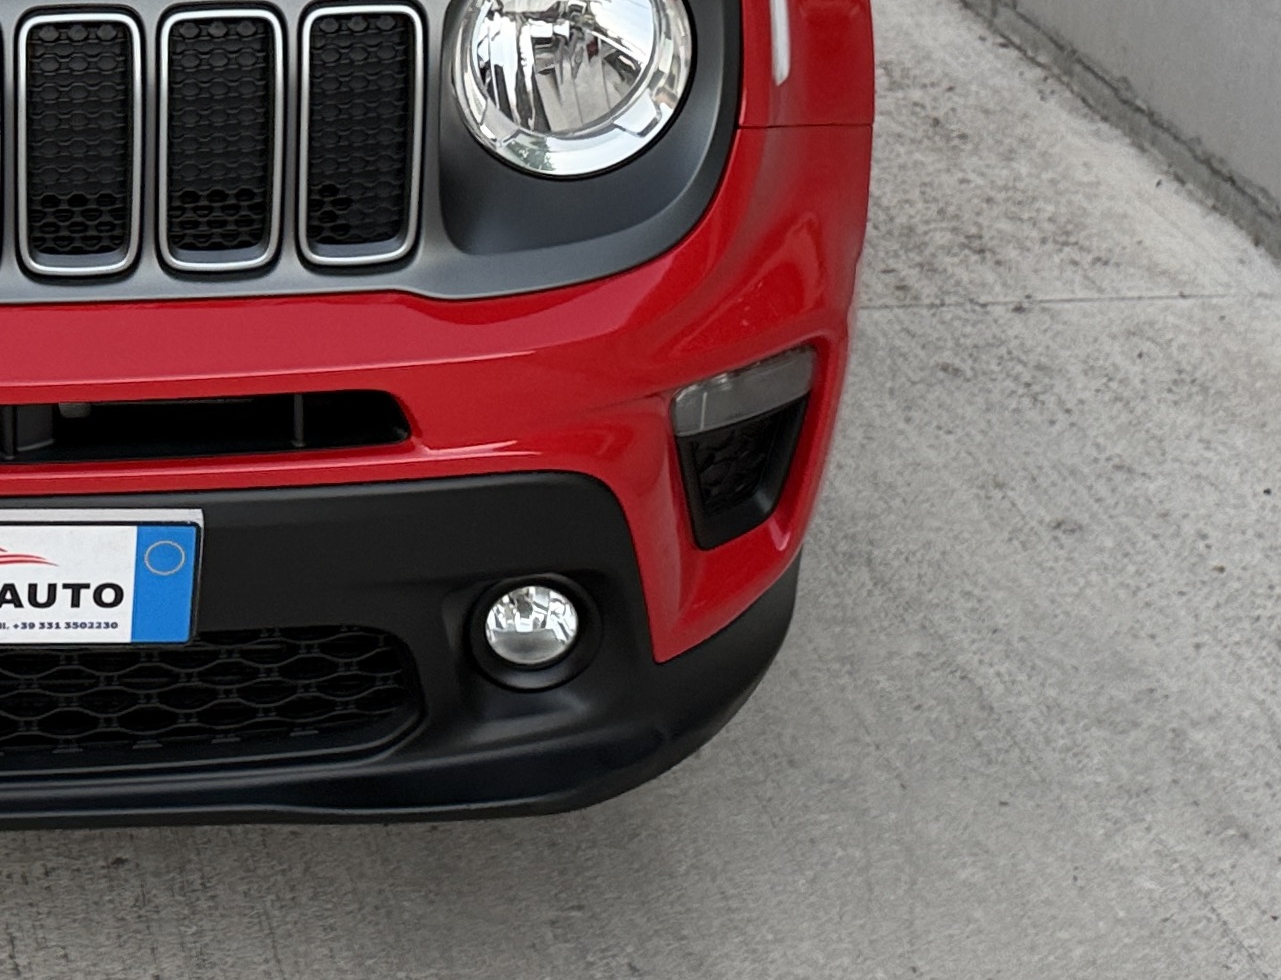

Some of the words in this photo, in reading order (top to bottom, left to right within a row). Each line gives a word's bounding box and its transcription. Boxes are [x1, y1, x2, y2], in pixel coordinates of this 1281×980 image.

[12, 621, 36, 630] +39
[38, 621, 62, 630] 331
[63, 621, 119, 630] 3502230
